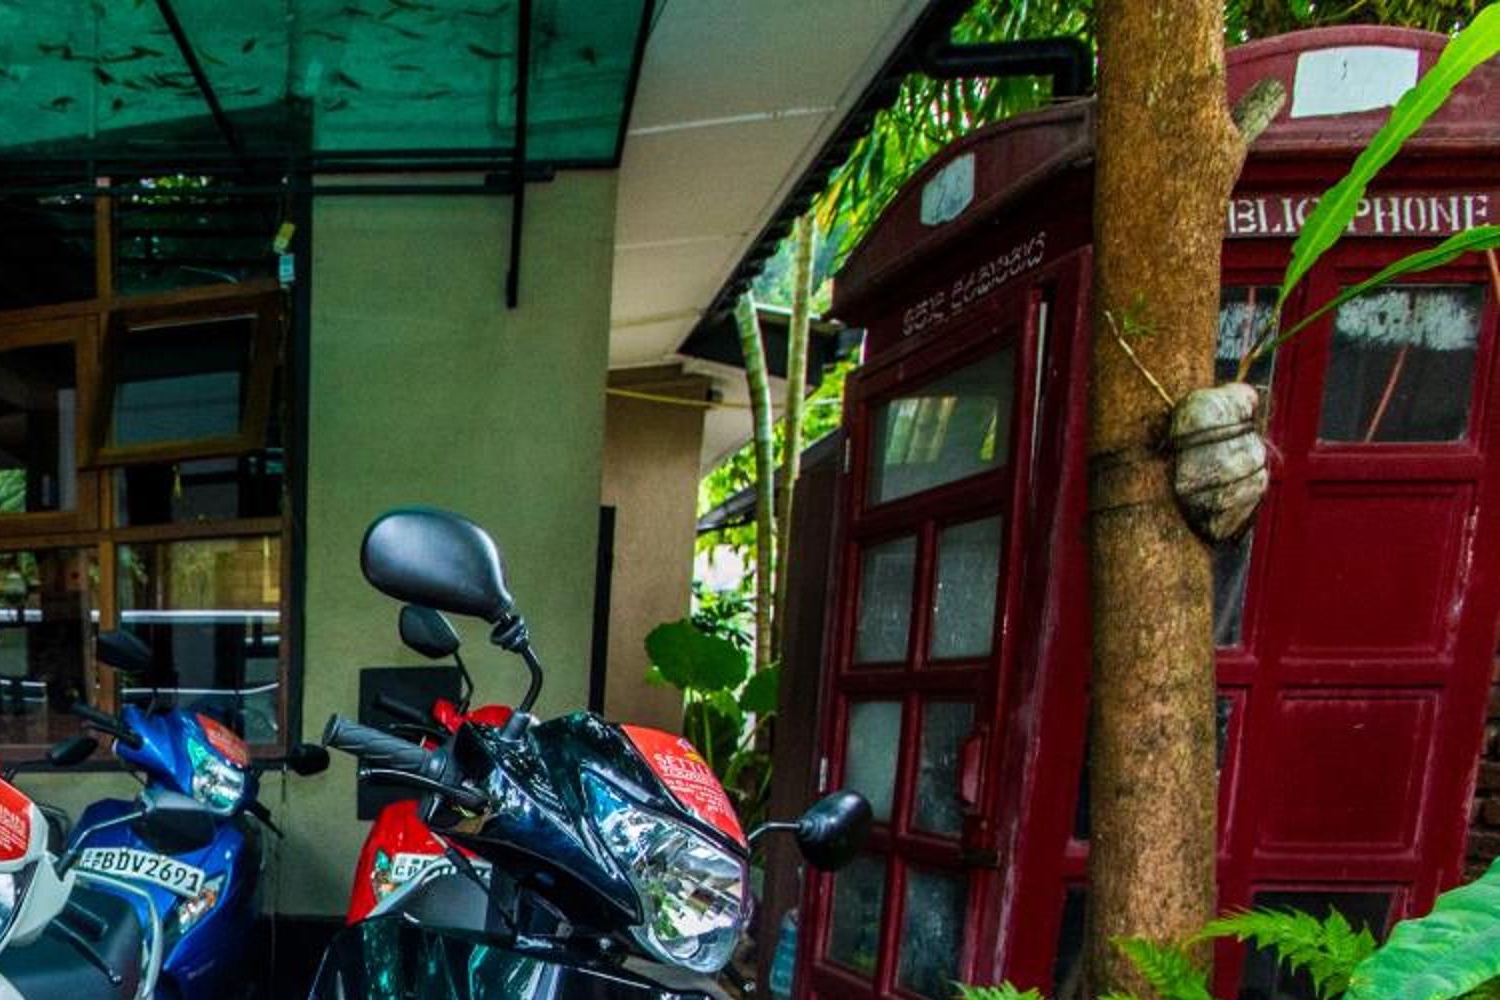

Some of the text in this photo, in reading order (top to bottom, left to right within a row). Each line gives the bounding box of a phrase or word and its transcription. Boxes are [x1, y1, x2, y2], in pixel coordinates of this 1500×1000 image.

[1228, 194, 1490, 234] BLIC PHONE
[101, 851, 200, 892] BDV2691
